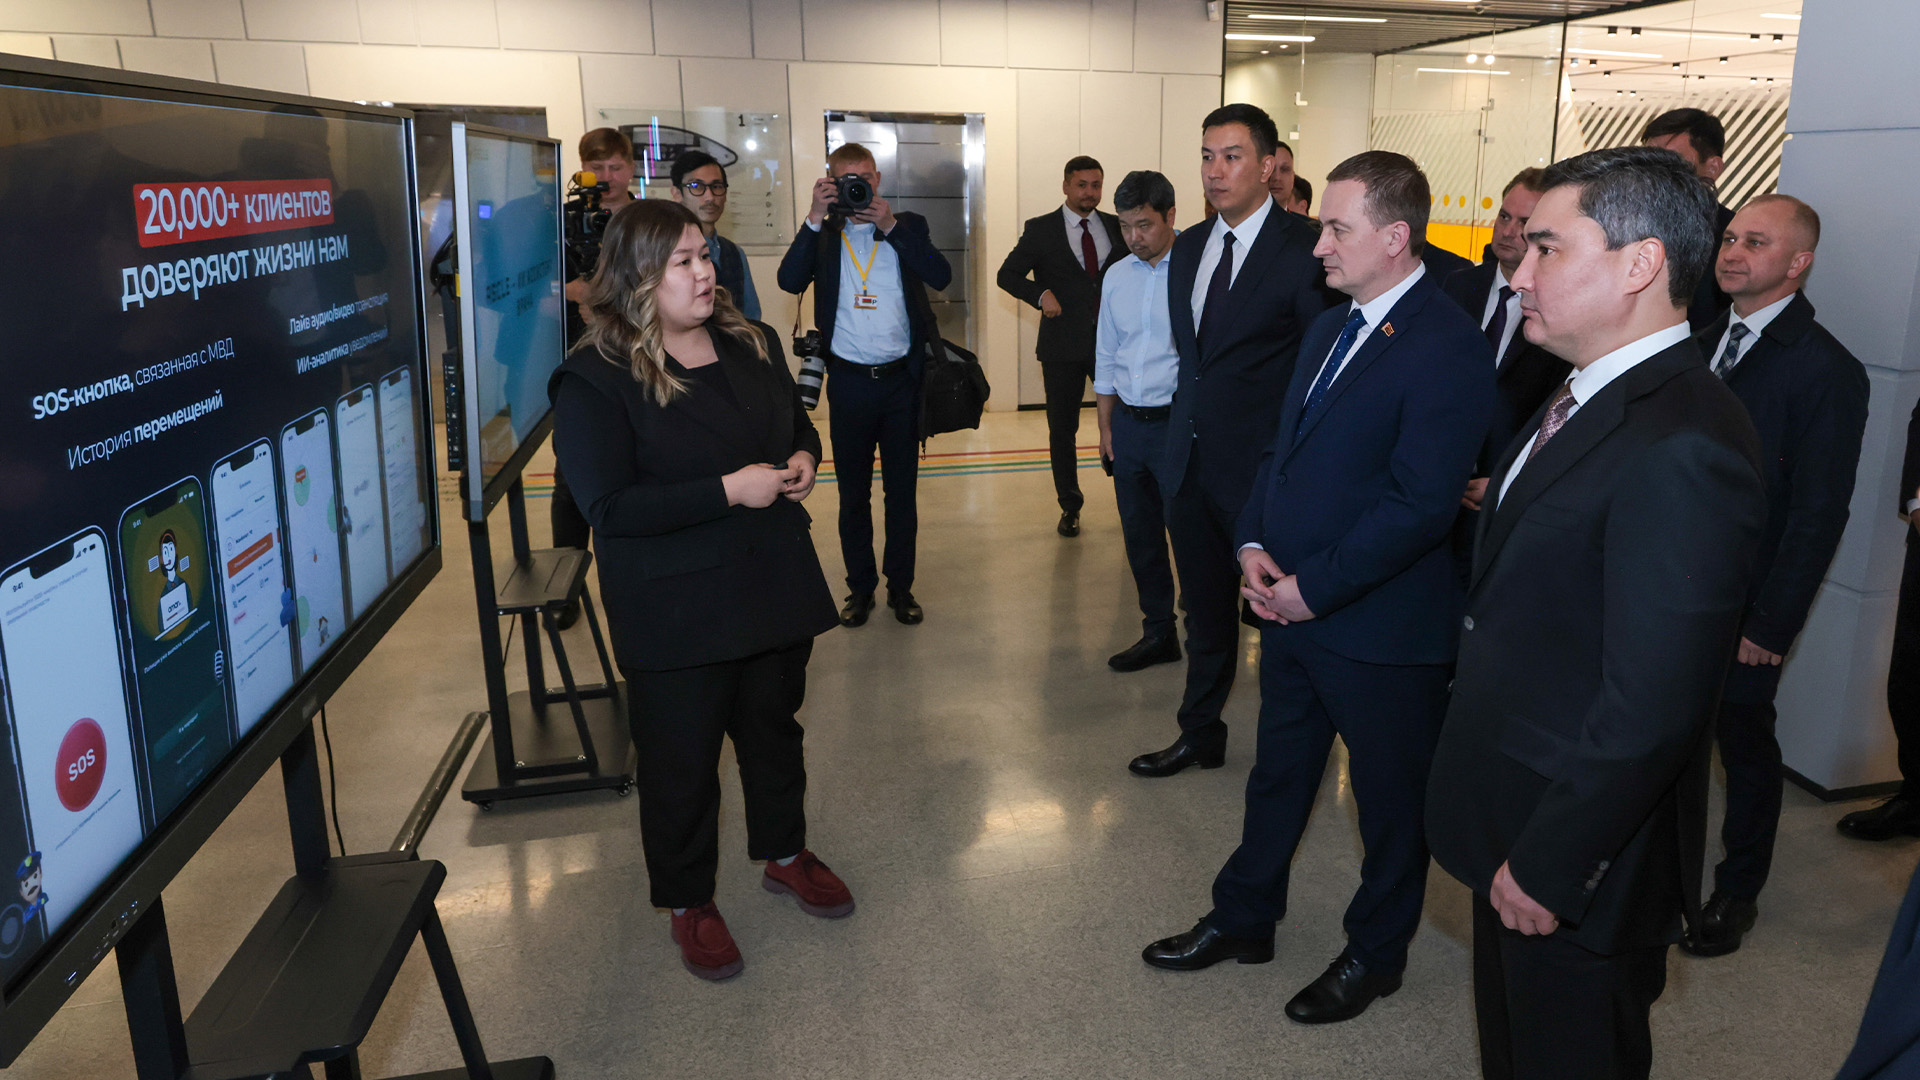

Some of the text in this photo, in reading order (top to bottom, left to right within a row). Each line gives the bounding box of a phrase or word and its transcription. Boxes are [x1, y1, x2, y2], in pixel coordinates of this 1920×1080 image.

[140, 187, 331, 239] 20,000+ клиентов
[122, 235, 347, 311] доверяют жизни нам
[290, 315, 311, 335] Лайв
[311, 303, 355, 330] аудио/видео
[32, 337, 235, 420] SOS-кнопка, связанная с МВД
[297, 343, 349, 374] ИИ-аналитика
[67, 390, 223, 470] История перемещений
[12, 581, 24, 592] 9:41
[68, 748, 96, 781] SOS
